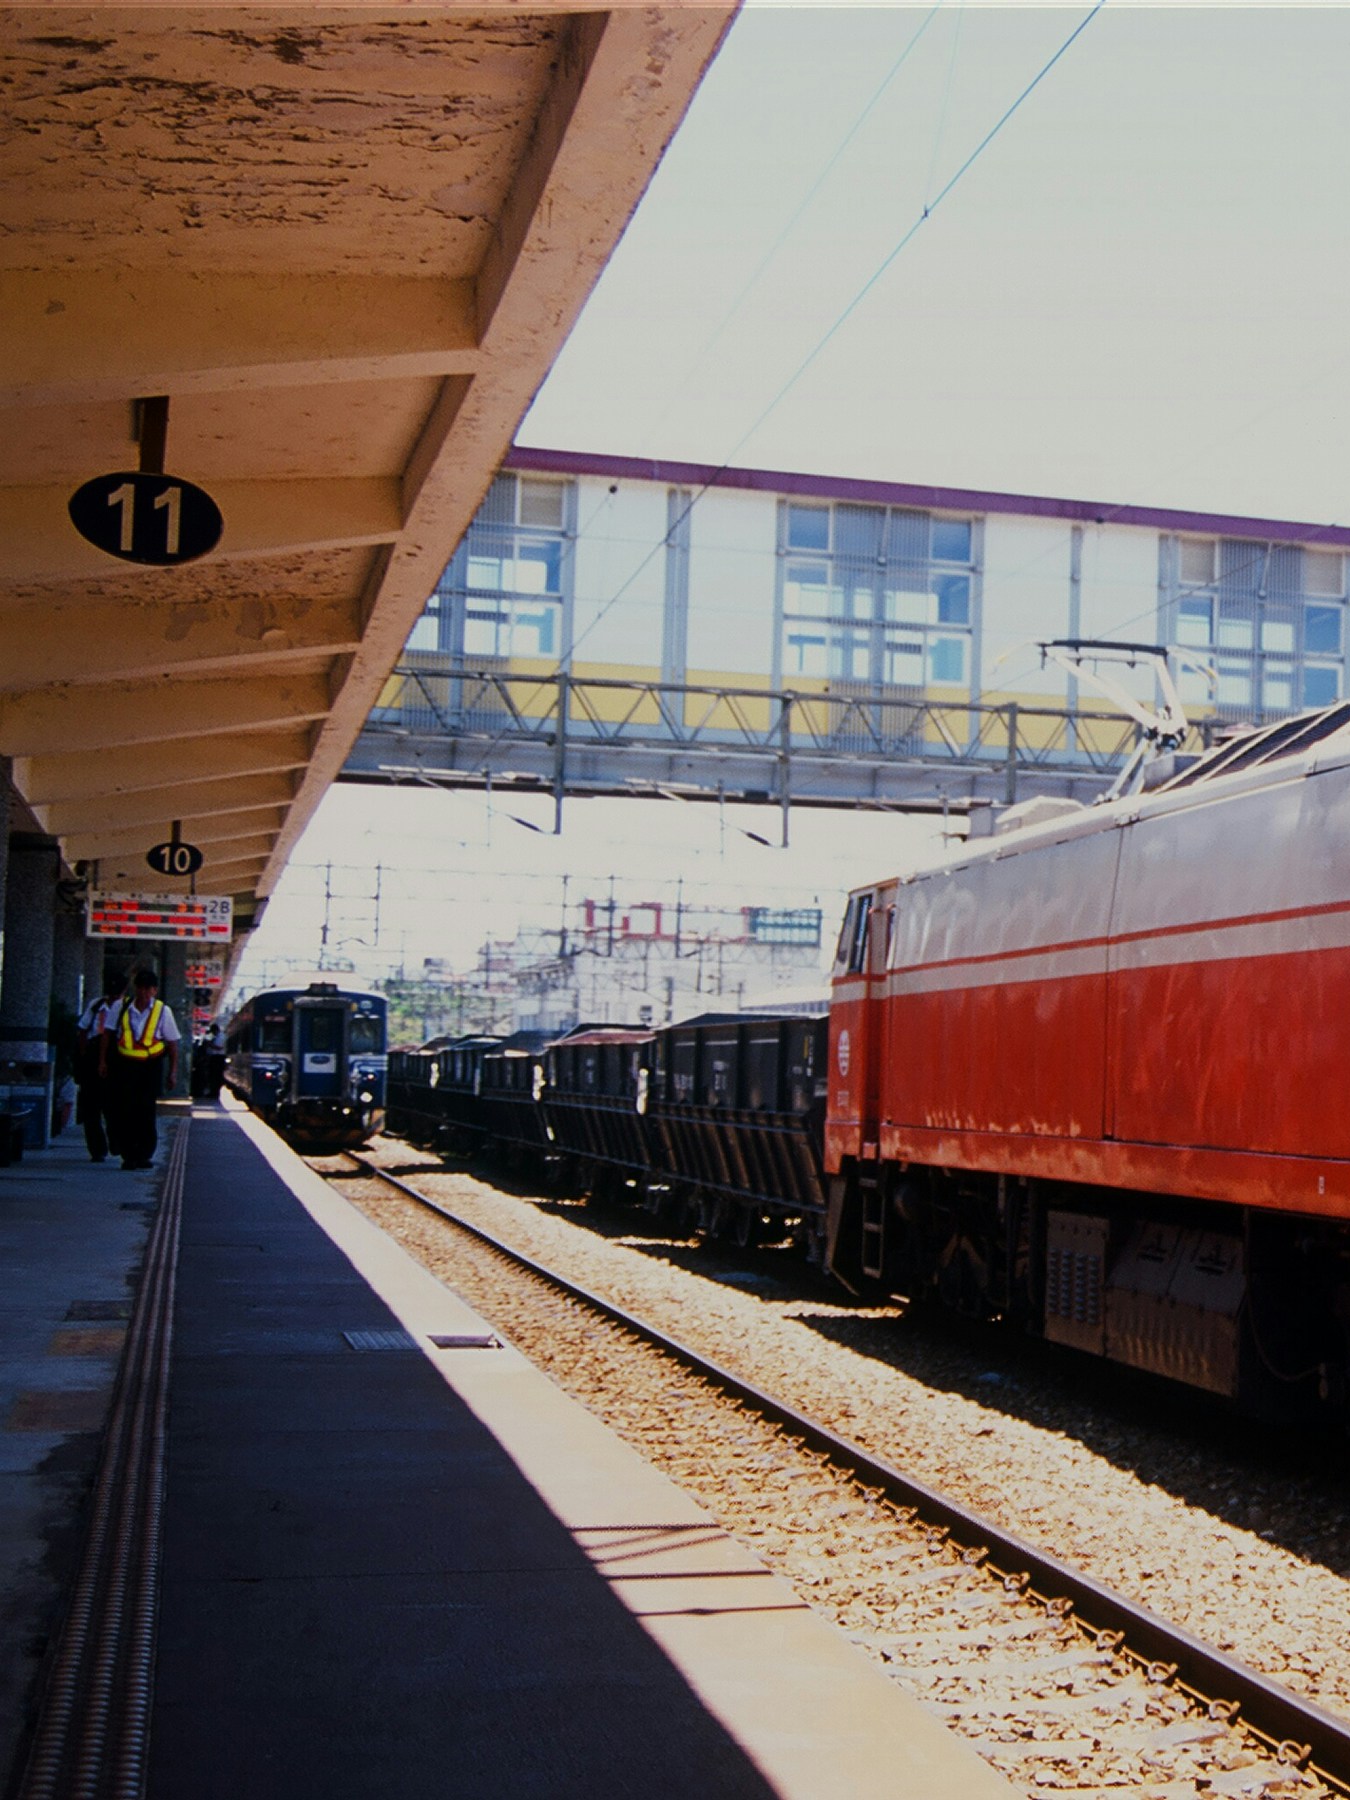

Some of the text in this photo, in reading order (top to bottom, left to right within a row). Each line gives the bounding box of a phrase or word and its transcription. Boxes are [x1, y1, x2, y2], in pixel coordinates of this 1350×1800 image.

[107, 482, 182, 554] 11
[160, 846, 191, 872] 10
[209, 900, 230, 914] 28
